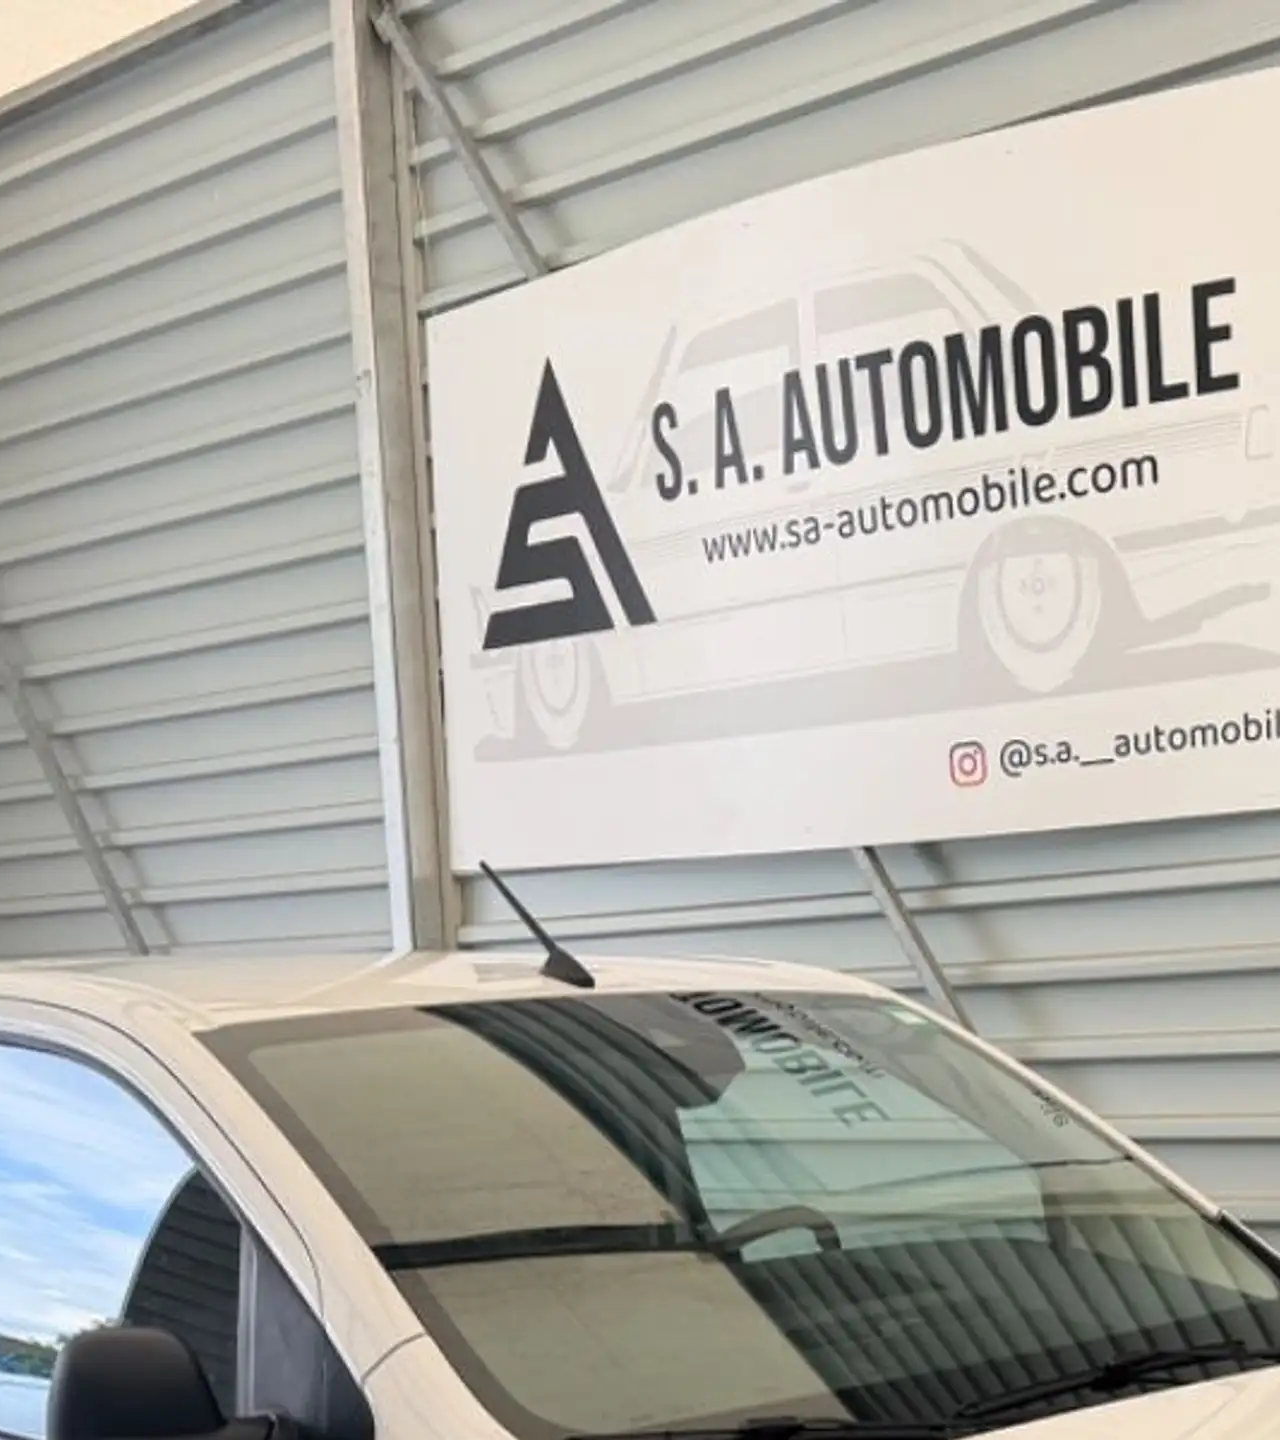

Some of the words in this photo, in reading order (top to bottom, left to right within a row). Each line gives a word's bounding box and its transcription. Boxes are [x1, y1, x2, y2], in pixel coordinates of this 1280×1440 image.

[651, 400, 698, 501] S.
[715, 387, 765, 489] A.
[782, 277, 1240, 475] AUTOMOBILE
[702, 453, 1159, 564] www.sa-automobile.com
